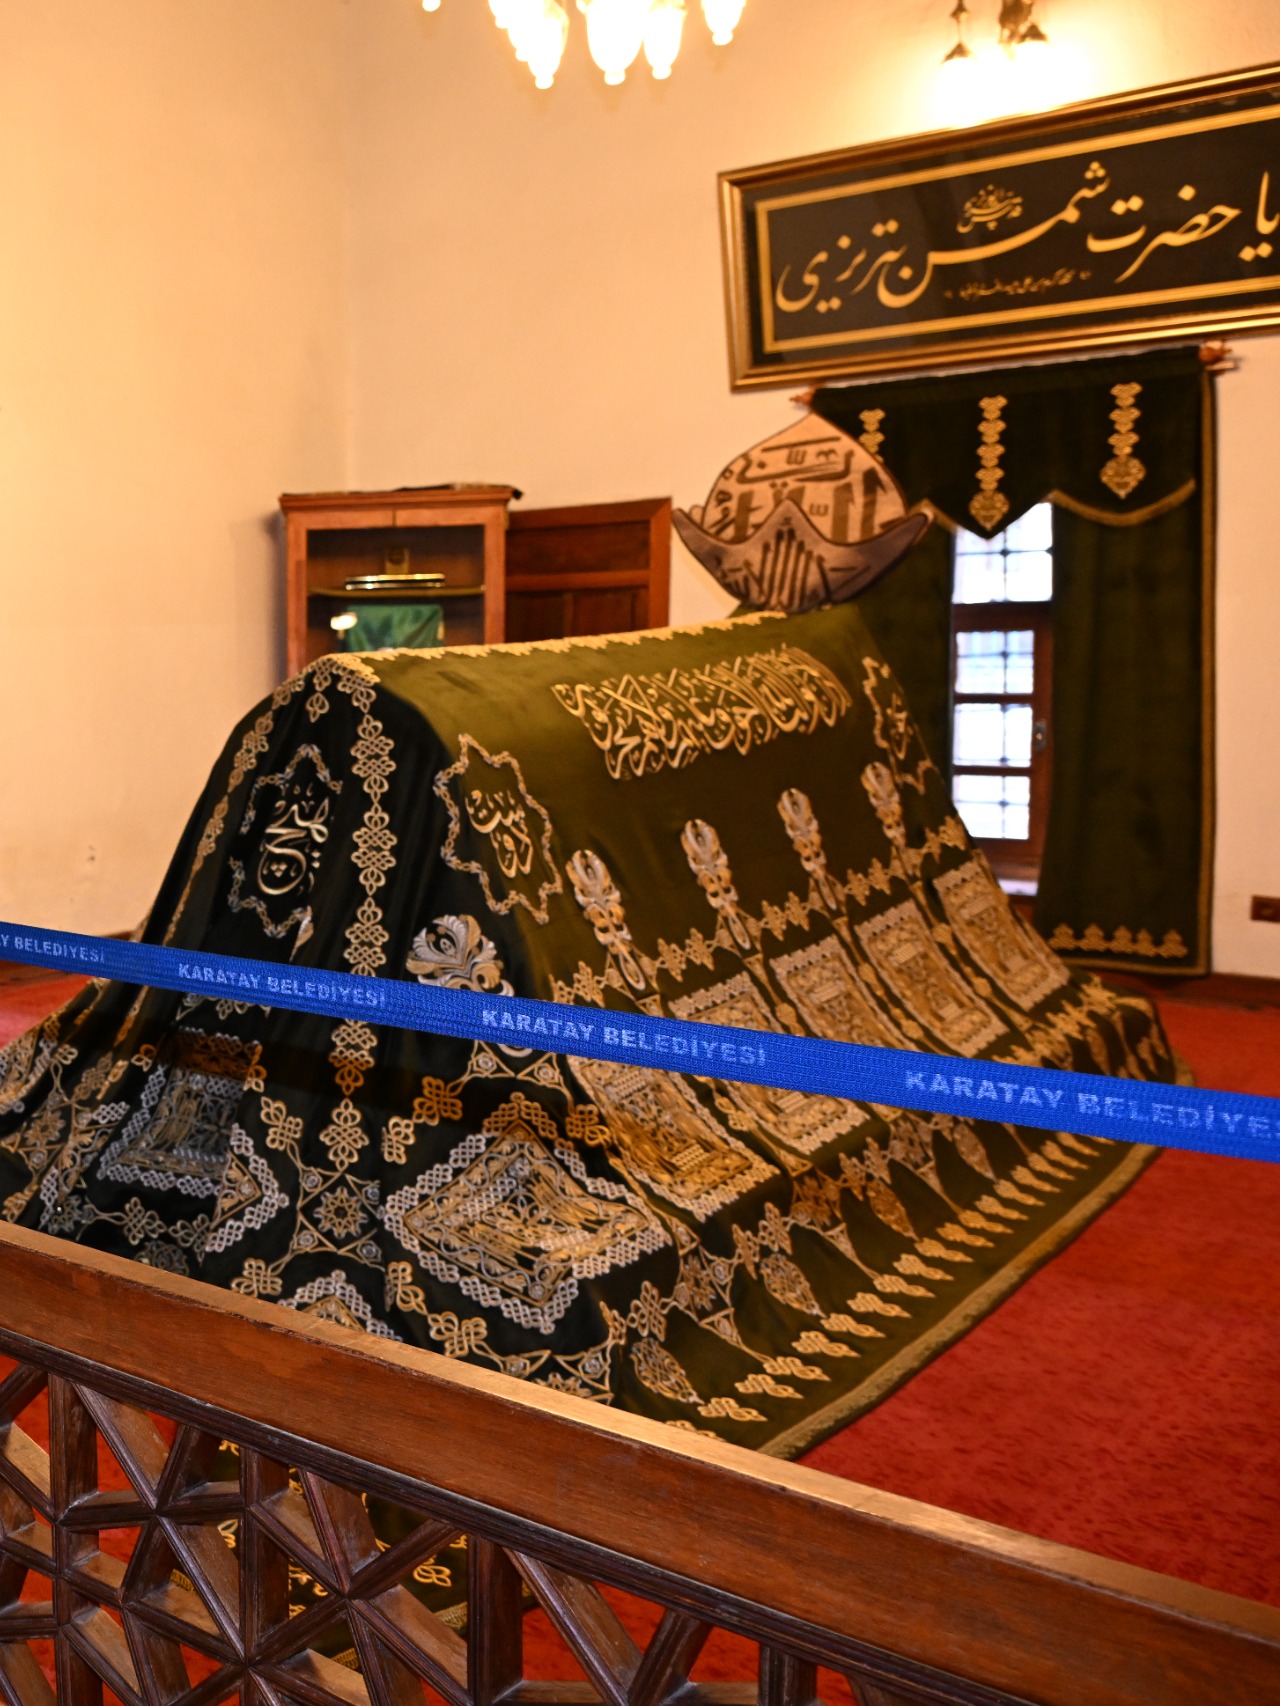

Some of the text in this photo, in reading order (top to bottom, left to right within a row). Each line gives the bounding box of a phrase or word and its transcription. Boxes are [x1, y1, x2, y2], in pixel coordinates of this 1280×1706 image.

[178, 963, 261, 989] KARATAY
[482, 1009, 595, 1042] KARATAY
[906, 1071, 1064, 1109] KARATAY
